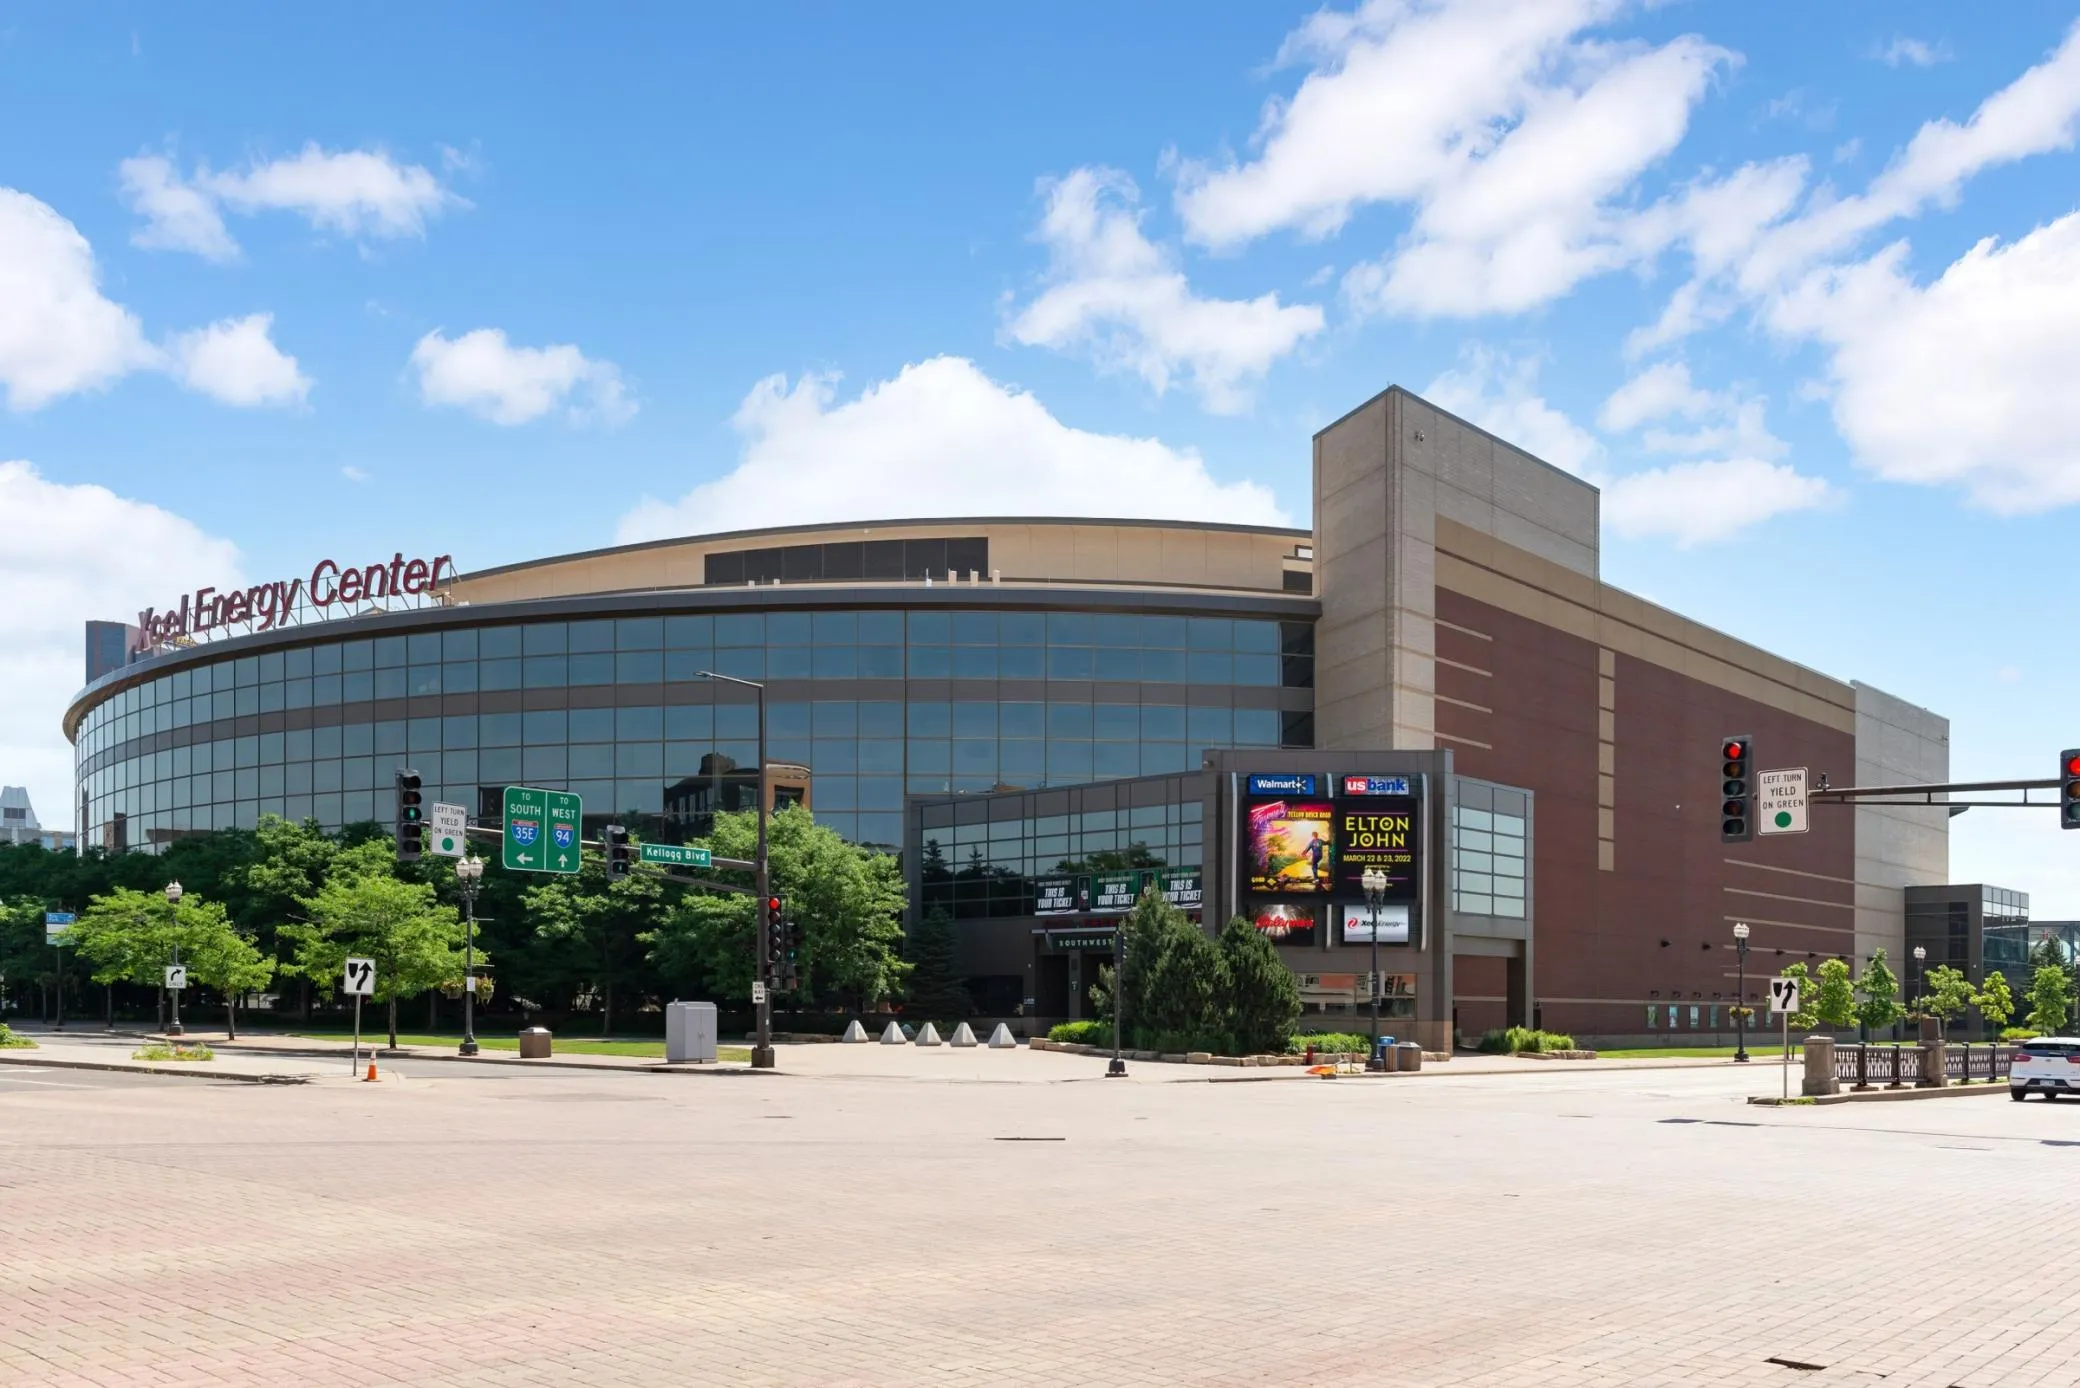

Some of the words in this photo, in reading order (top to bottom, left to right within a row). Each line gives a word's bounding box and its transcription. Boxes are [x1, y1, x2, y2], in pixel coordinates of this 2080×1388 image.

[136, 594, 189, 650] Xcel
[193, 578, 302, 631] Energy
[311, 552, 452, 607] Center
[1257, 779, 1296, 789] Walmart
[1763, 775, 1780, 784] LEFT
[1783, 773, 1802, 783] TURN
[521, 792, 531, 801] TO
[1770, 786, 1796, 797] YIELD
[560, 797, 569, 805] TO
[1762, 801, 1773, 810] ON
[1776, 799, 1804, 809] GREEN
[434, 806, 448, 815] LEFT
[450, 806, 465, 816] TURN
[510, 803, 541, 816] SOUTH
[552, 808, 577, 820] WEST
[440, 818, 459, 827] YIELD
[1345, 816, 1409, 831] ELTON
[434, 827, 442, 835] ON
[445, 828, 463, 837] GREEN
[515, 826, 534, 840] 35E
[556, 830, 570, 843] 94
[1349, 832, 1405, 848] JOHN
[646, 847, 682, 861] Kellogg
[685, 850, 706, 861] Blvd
[1343, 854, 1366, 862] MARCH
[1366, 854, 1375, 862] 22
[1394, 854, 1412, 863] 2022
[1104, 884, 1119, 894] THIS
[1119, 884, 1127, 894] IS
[1170, 880, 1184, 890] THIS
[1184, 880, 1193, 890] IS
[1044, 887, 1058, 898] THIS
[1058, 887, 1065, 898] IS
[1179, 889, 1203, 901] TICKET
[1037, 897, 1053, 909] YOUR
[1053, 896, 1073, 908] TICKET
[1097, 894, 1113, 906] YOUR
[1113, 893, 1135, 905] TICKET
[1059, 938, 1112, 947] SOUTHWEST
